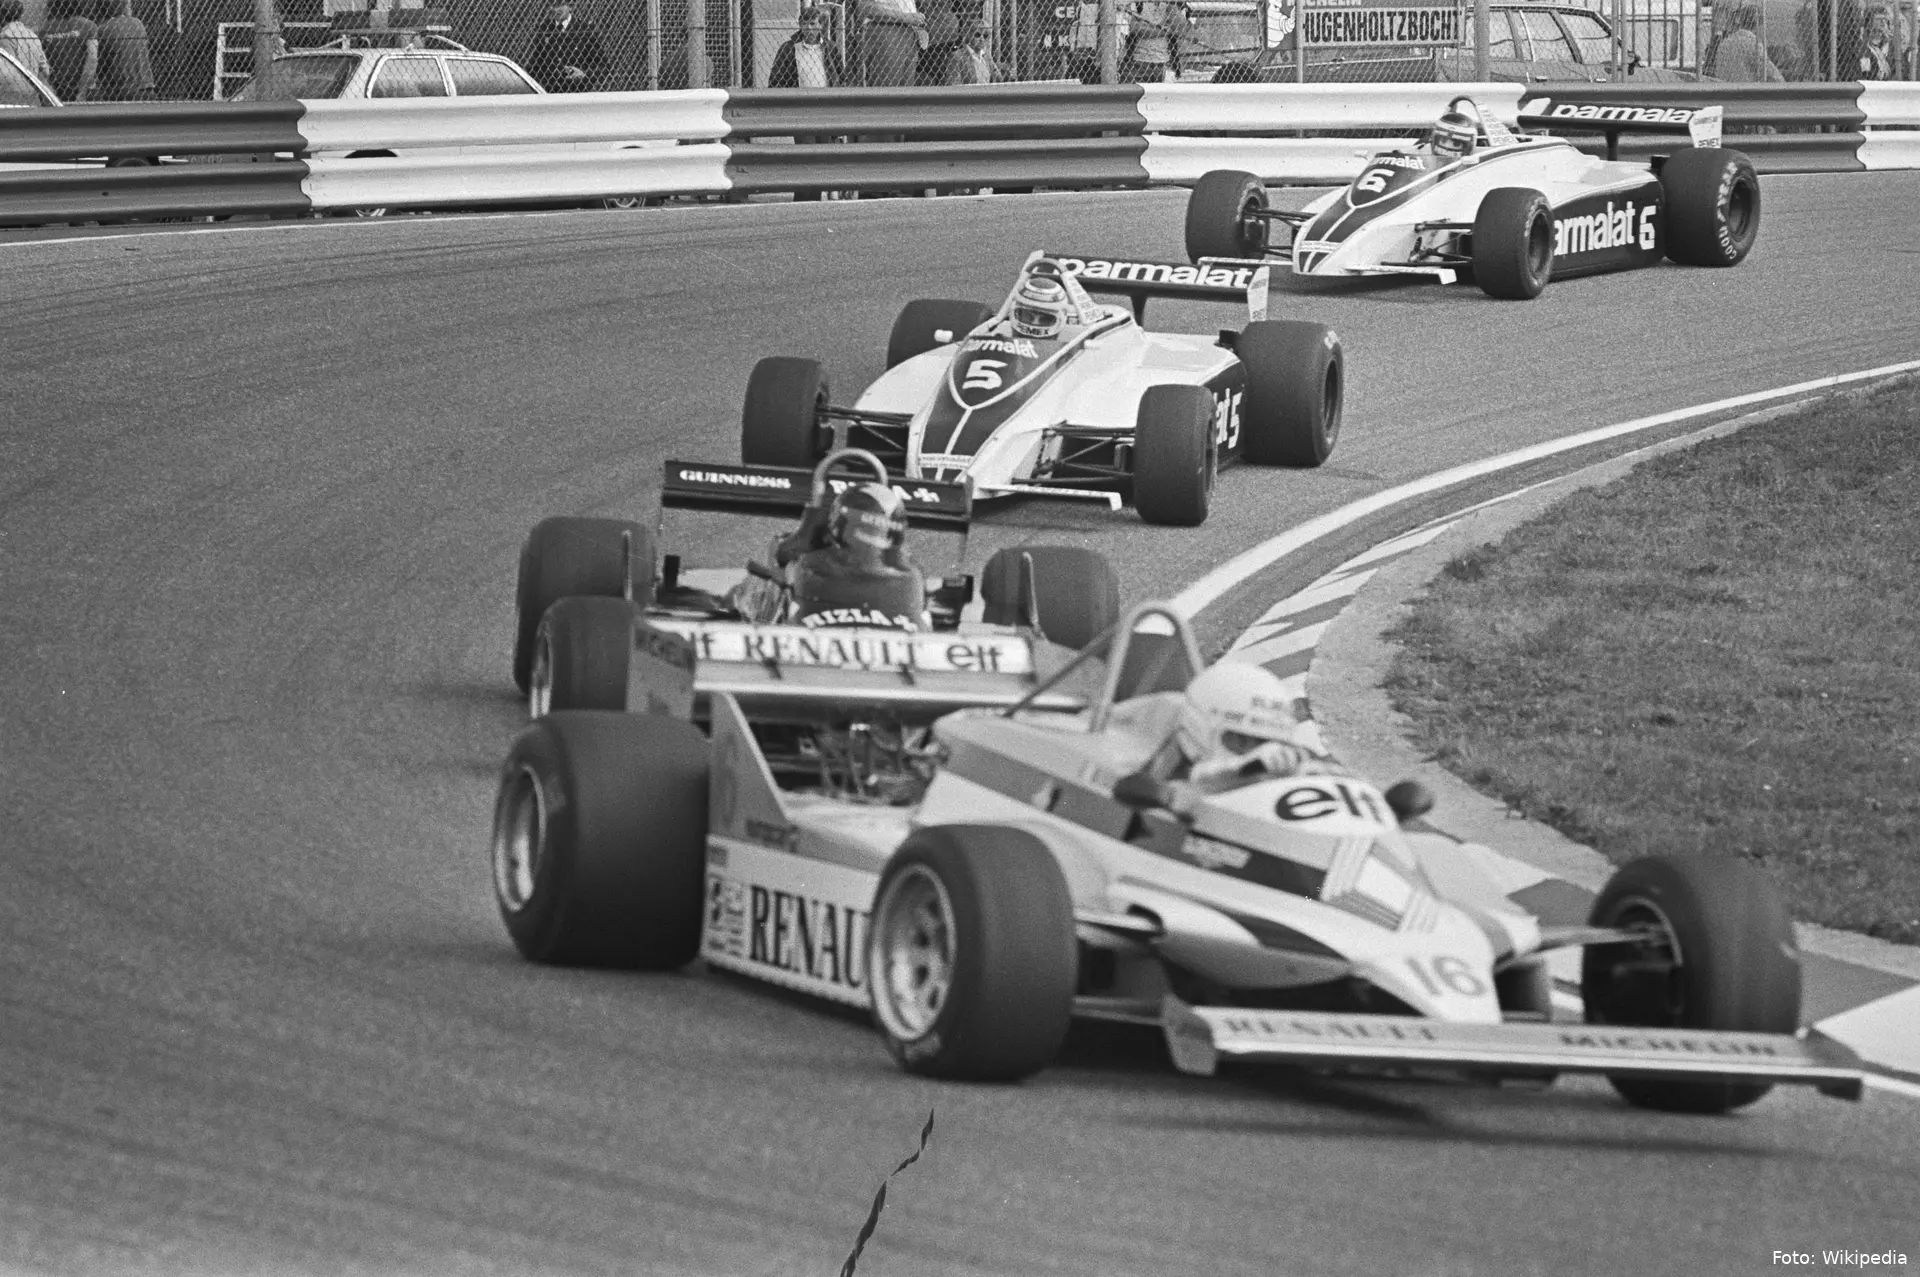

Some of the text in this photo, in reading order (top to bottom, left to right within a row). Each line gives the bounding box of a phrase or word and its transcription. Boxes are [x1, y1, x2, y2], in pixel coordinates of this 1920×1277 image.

[1357, 168, 1395, 193] 6
[1053, 258, 1252, 288] parmalat
[962, 359, 1009, 390] 5
[1228, 392, 1243, 449] 5
[744, 634, 918, 674] RENAULT
[947, 643, 1003, 672] elf
[1274, 783, 1389, 822] elf
[750, 884, 872, 988] RENAU
[1405, 956, 1486, 997] 16
